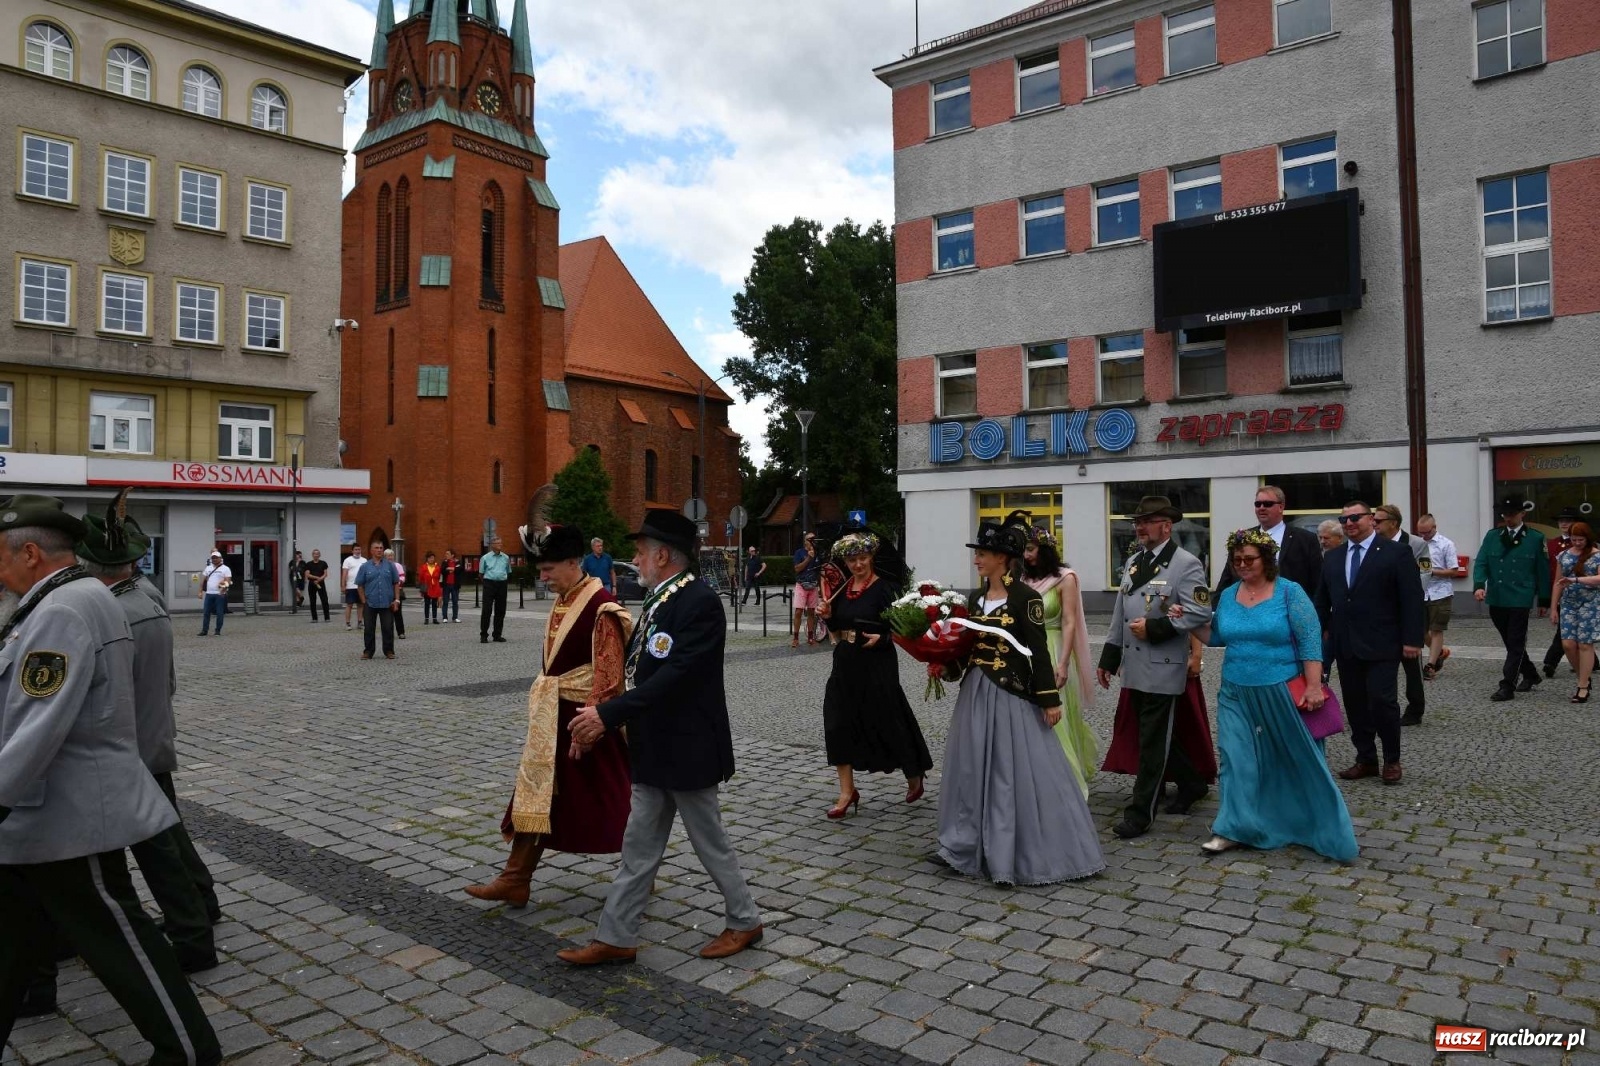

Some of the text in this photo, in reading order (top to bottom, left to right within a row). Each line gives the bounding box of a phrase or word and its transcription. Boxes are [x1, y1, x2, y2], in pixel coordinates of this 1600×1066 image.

[1214, 202, 1286, 221] tel. 533 355 677
[1205, 302, 1302, 322] Telebimy-Raciborz.pl
[928, 404, 1345, 463] BOLKO zaprasza
[173, 463, 302, 485] ROSSMANN
